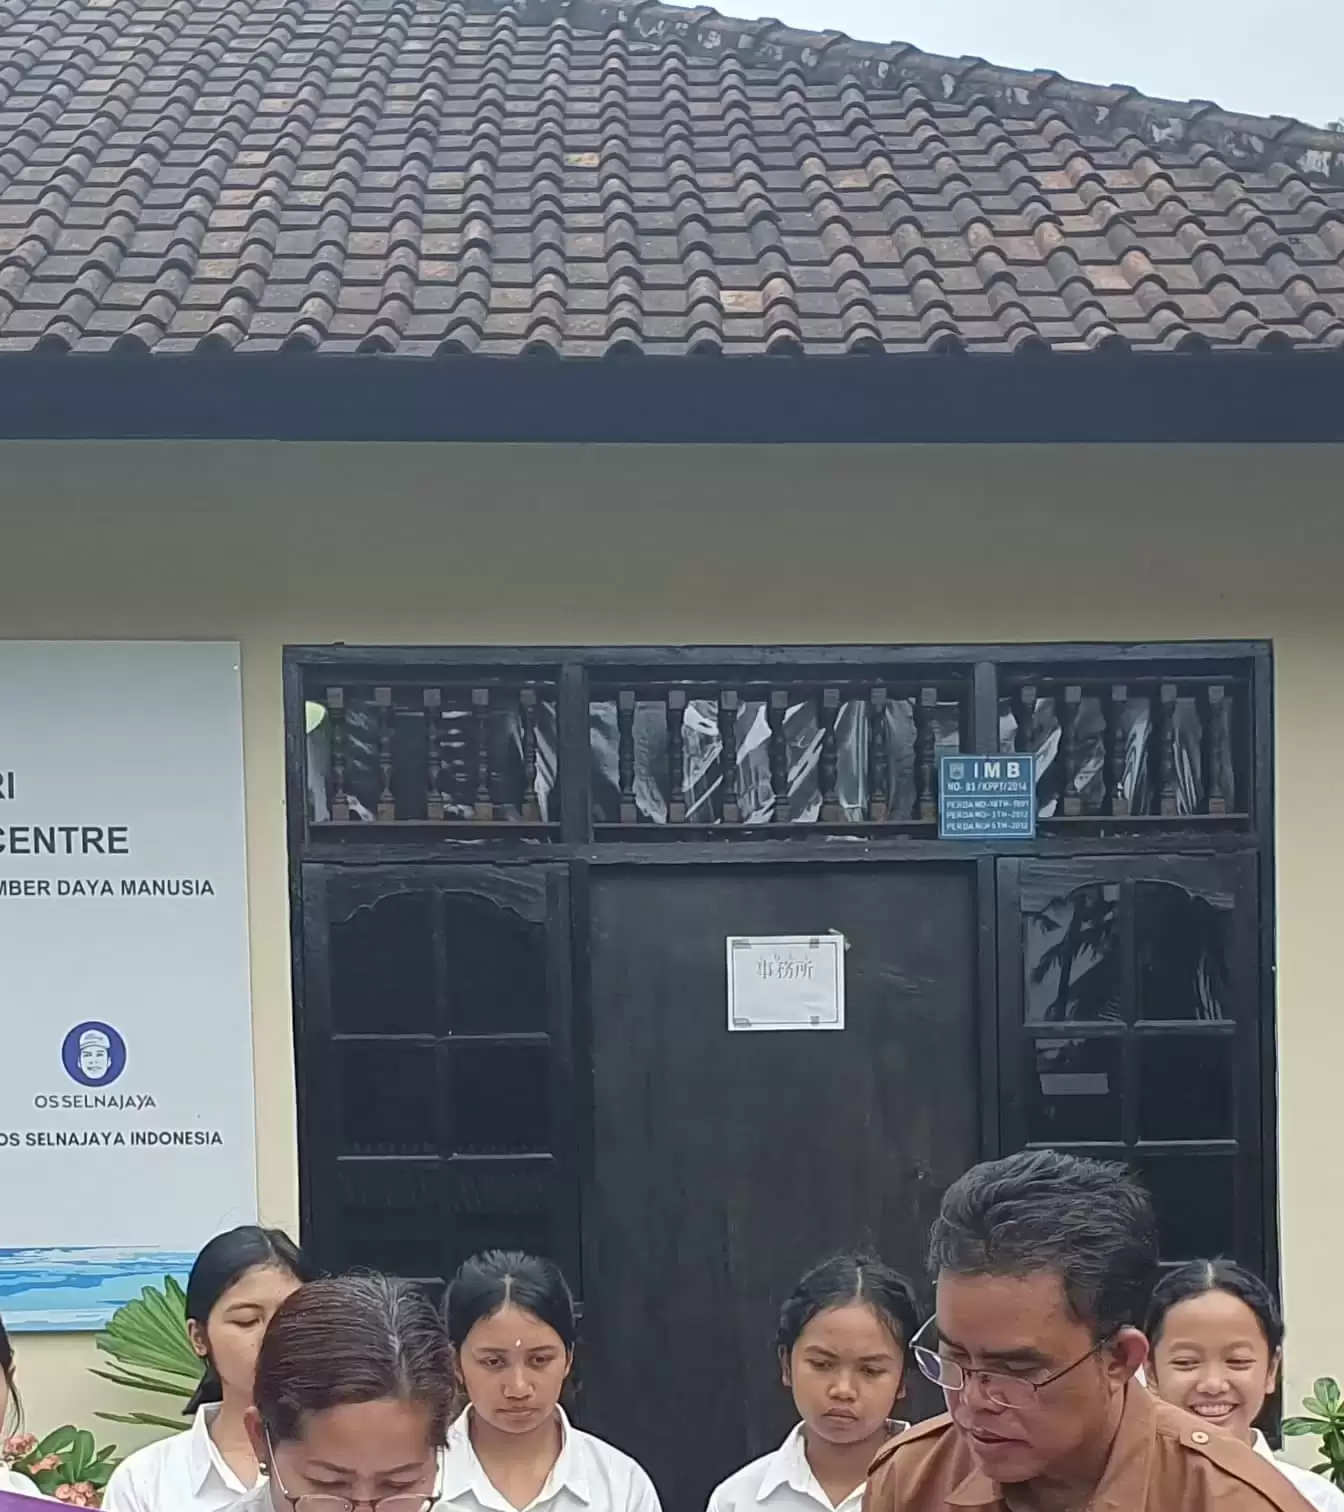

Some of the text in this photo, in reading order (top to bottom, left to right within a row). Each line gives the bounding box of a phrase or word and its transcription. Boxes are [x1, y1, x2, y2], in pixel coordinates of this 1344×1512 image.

[974, 762, 1021, 779] IMB
[57, 879, 114, 896] DAYA
[120, 879, 215, 896] MANUSIA
[62, 1094, 156, 1111] SELNAJAYA
[25, 1131, 125, 1147] SELNAJAYA
[130, 1130, 223, 1146] INDONESIA
